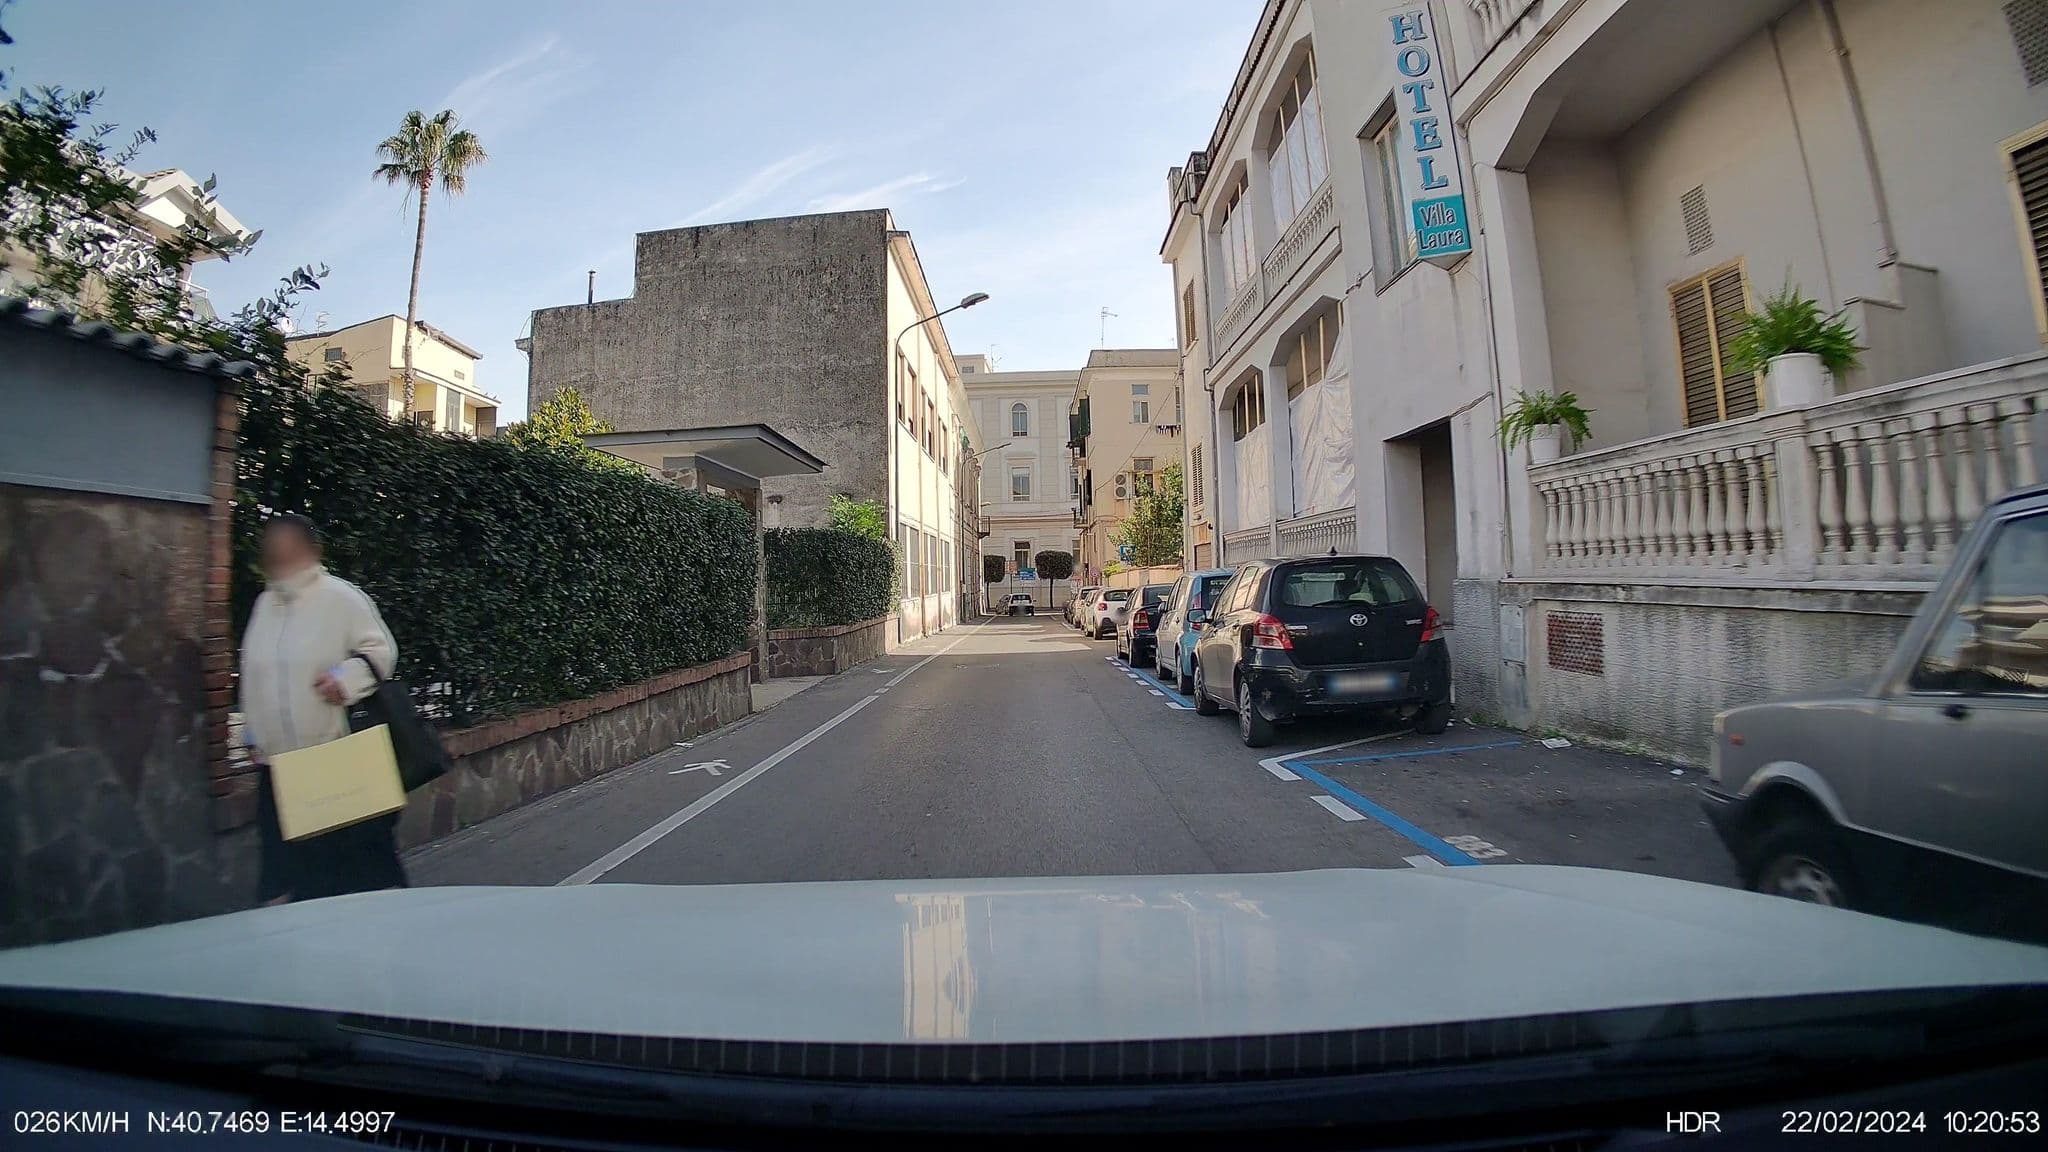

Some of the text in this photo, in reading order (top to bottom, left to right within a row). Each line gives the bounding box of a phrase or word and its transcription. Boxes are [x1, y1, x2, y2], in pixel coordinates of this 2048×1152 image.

[1388, 9, 1448, 191] HOTEL
[1419, 202, 1457, 227] Villa
[1418, 229, 1465, 250] Laura
